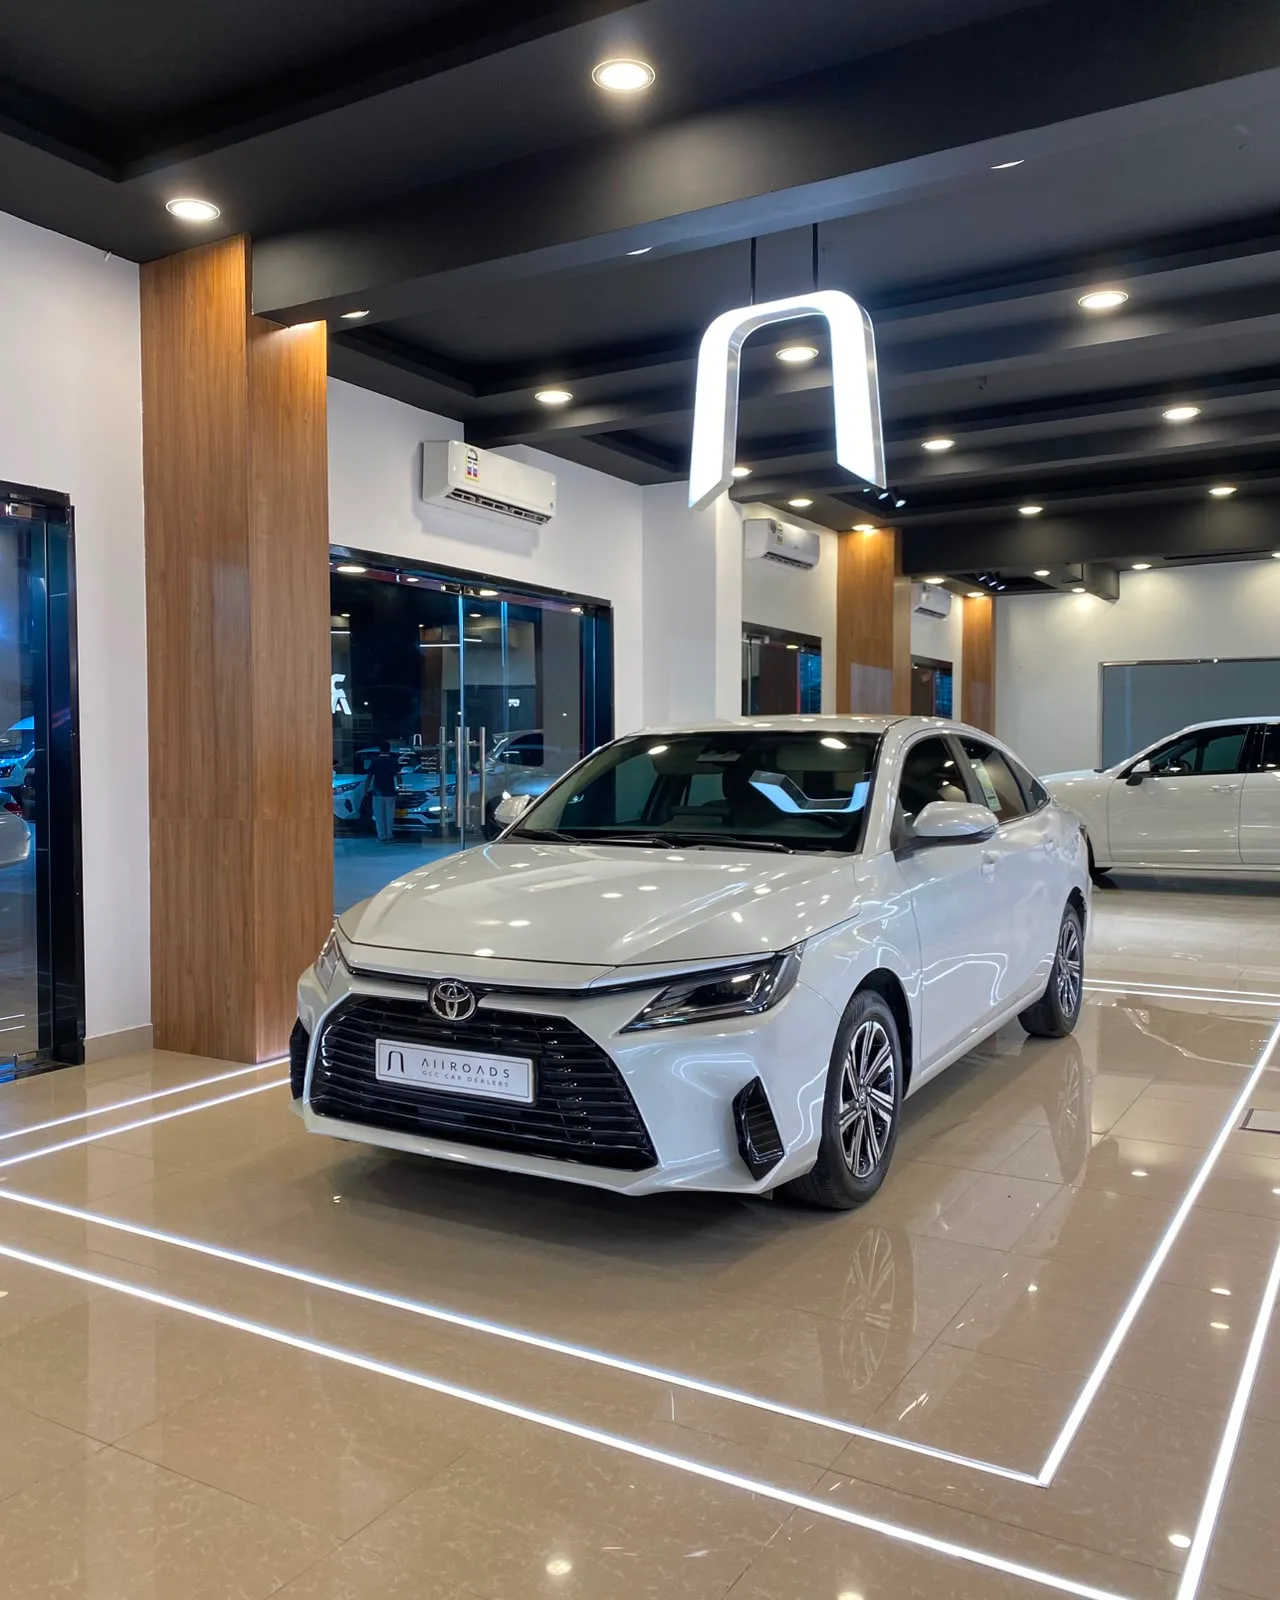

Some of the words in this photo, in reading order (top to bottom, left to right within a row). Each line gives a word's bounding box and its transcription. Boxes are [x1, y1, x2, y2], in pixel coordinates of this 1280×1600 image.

[422, 1070, 440, 1078] GCC
[444, 1073, 461, 1081] CAR
[467, 1077, 509, 1088] DEALERS
